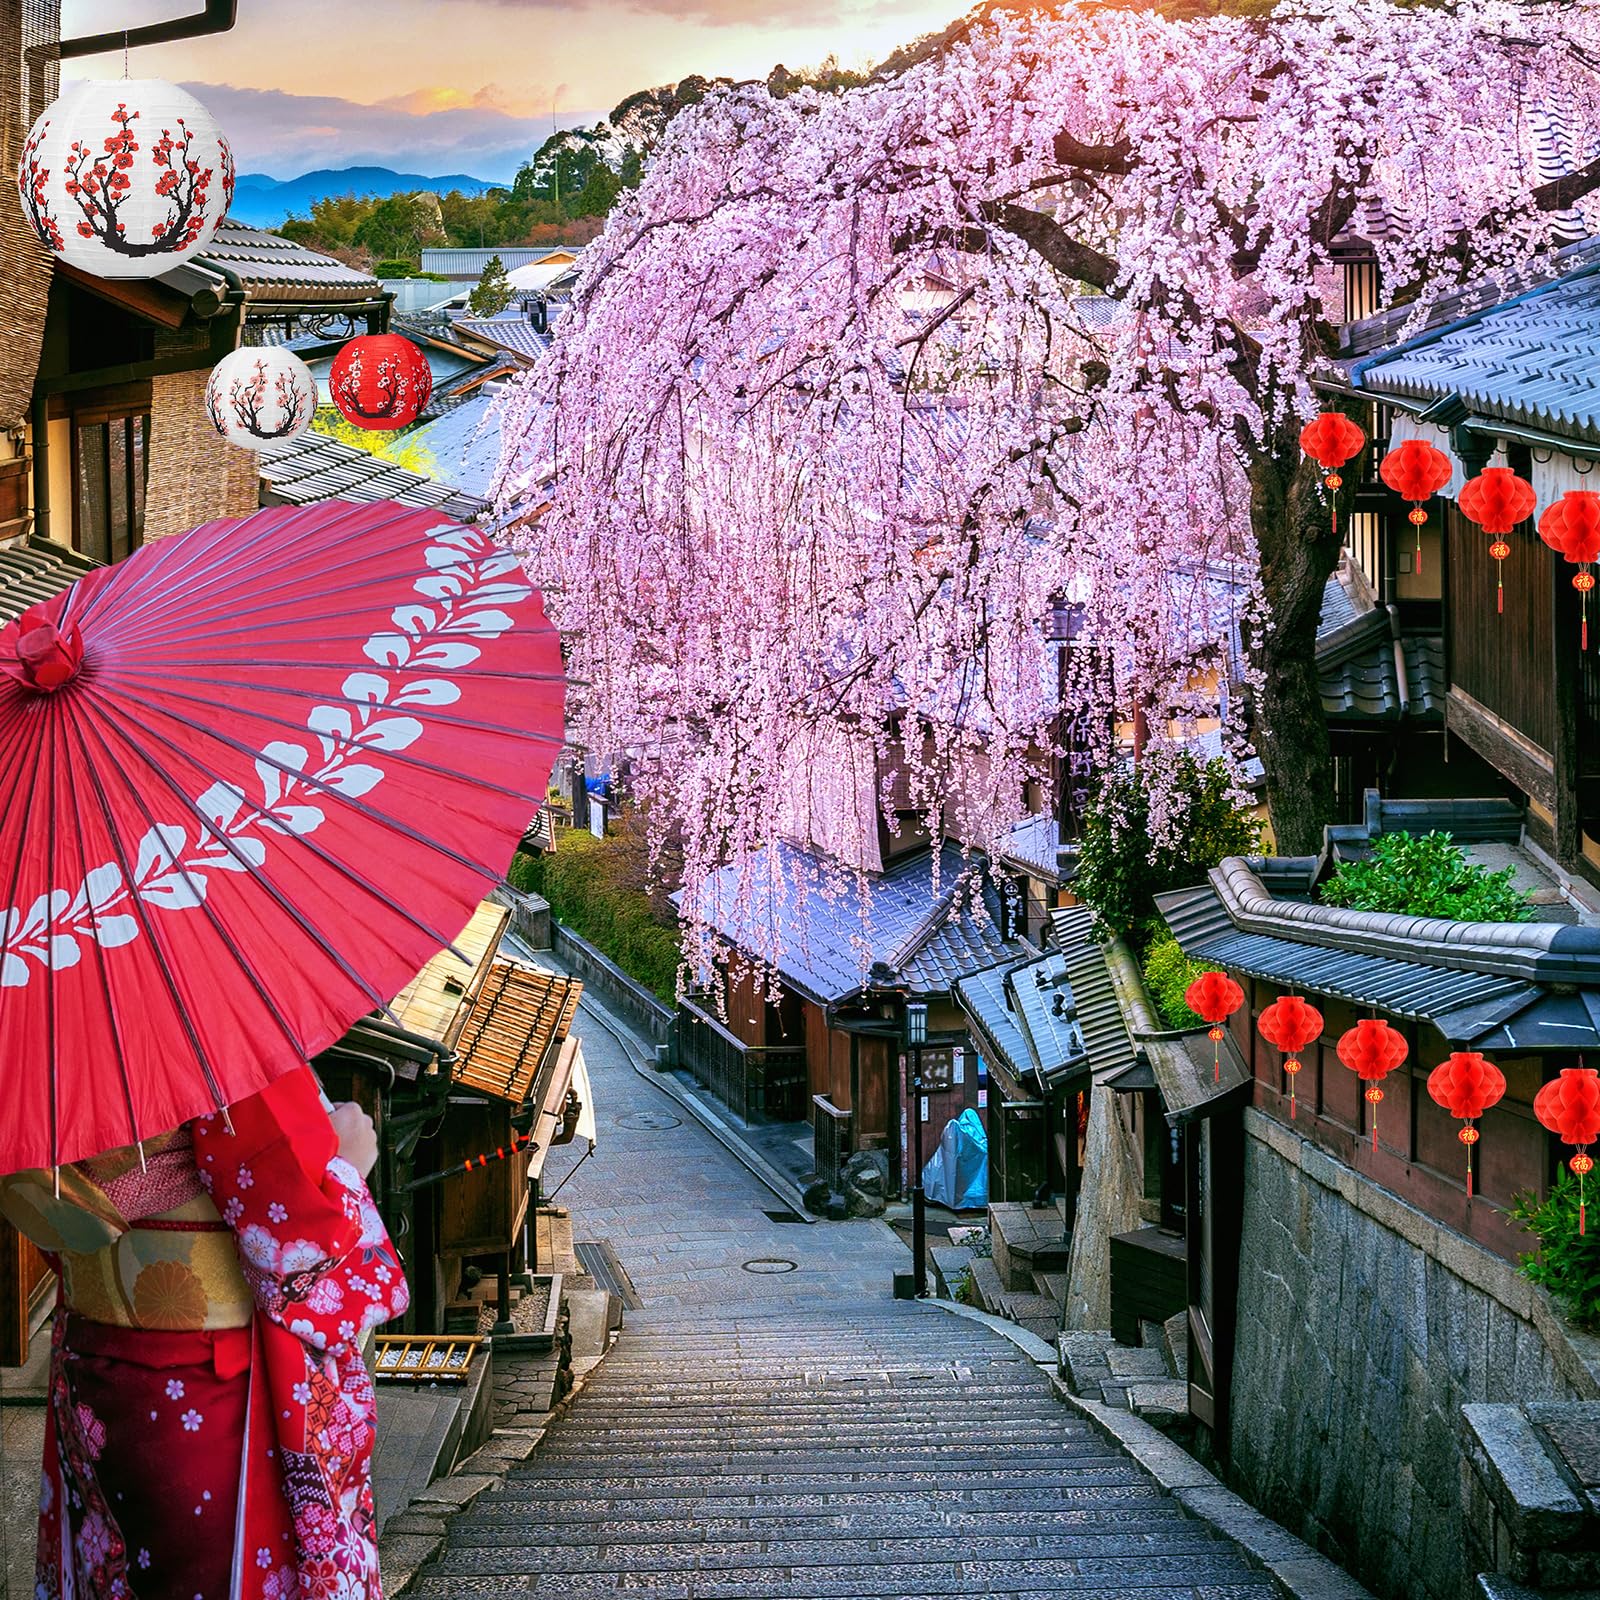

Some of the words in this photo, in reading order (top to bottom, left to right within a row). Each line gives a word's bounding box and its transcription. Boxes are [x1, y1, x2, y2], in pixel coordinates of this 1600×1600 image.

[1413, 511, 1424, 522] 福
[1493, 544, 1506, 556] 福
[1576, 575, 1590, 588] 福
[1368, 1090, 1380, 1100] 福
[1462, 1129, 1475, 1141] 福
[1574, 1156, 1588, 1170] 福
